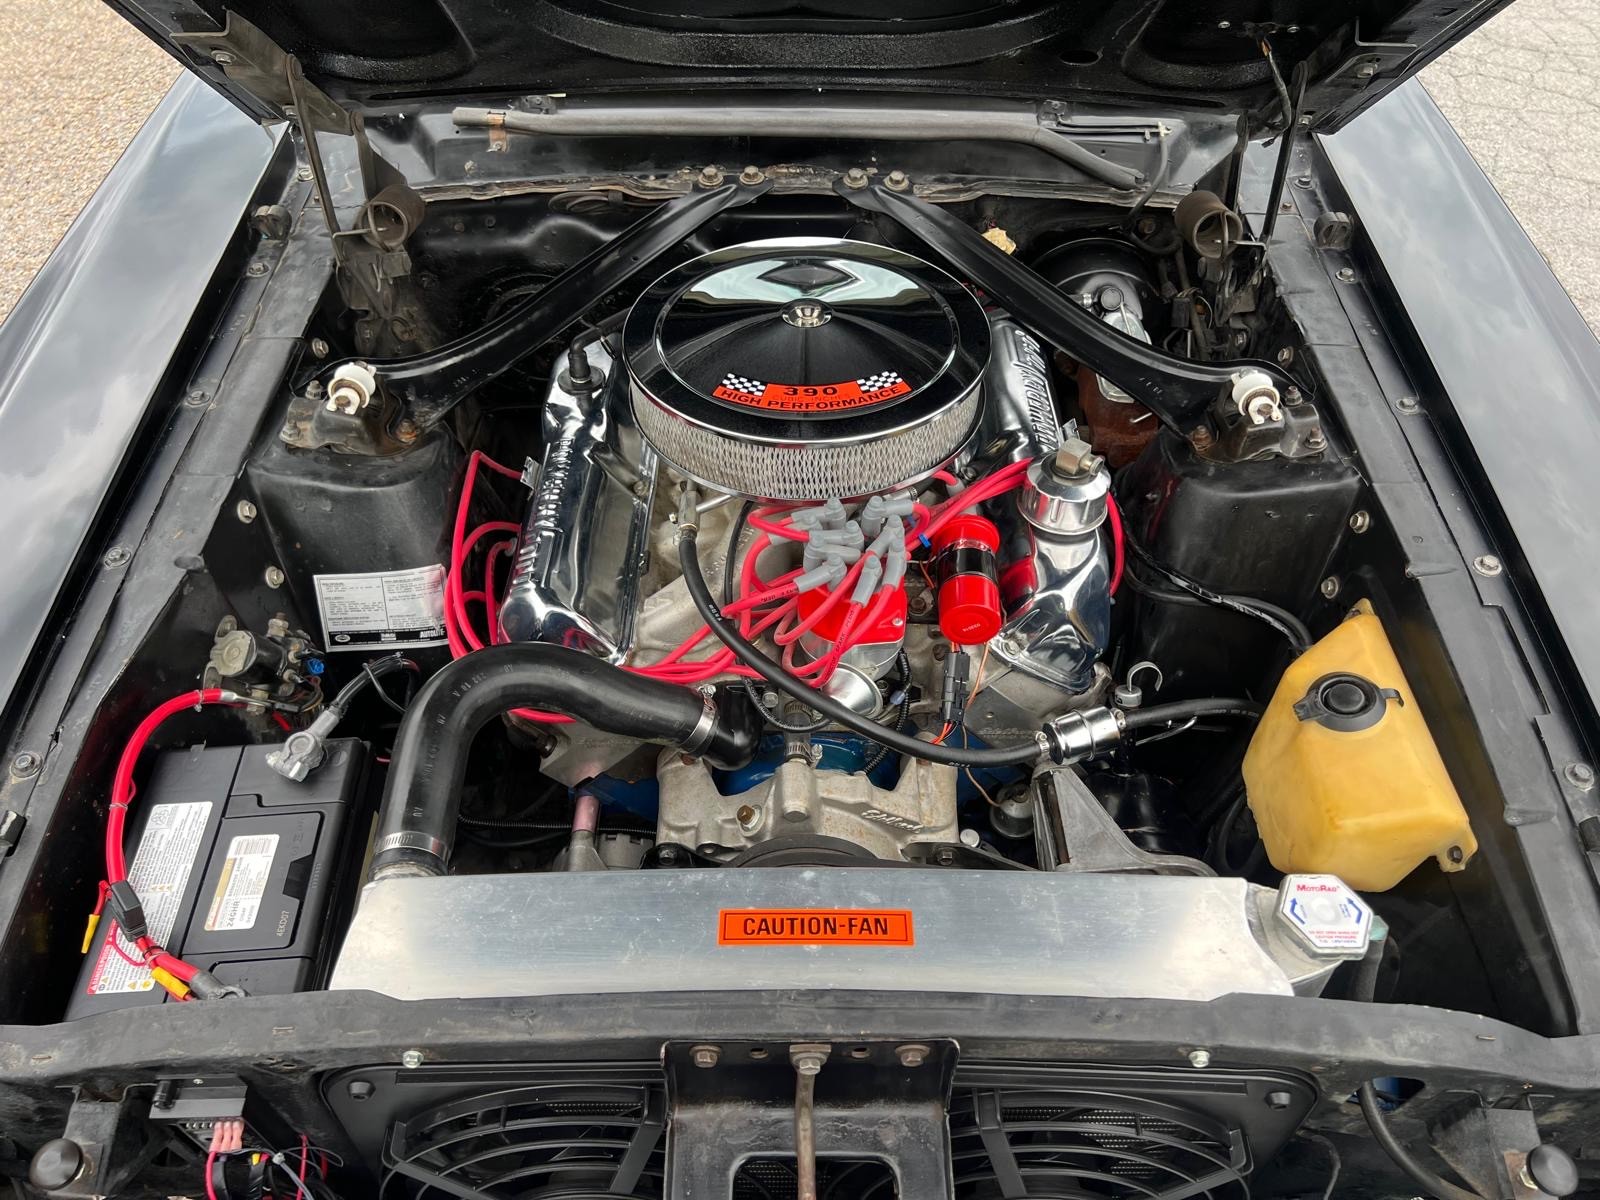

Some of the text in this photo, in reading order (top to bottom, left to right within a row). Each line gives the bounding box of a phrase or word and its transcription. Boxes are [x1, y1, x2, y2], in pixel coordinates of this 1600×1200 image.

[720, 386, 901, 410] HIGH PERFORMANCE
[783, 386, 838, 397] 390
[743, 917, 888, 936] CAUTION-FAN
